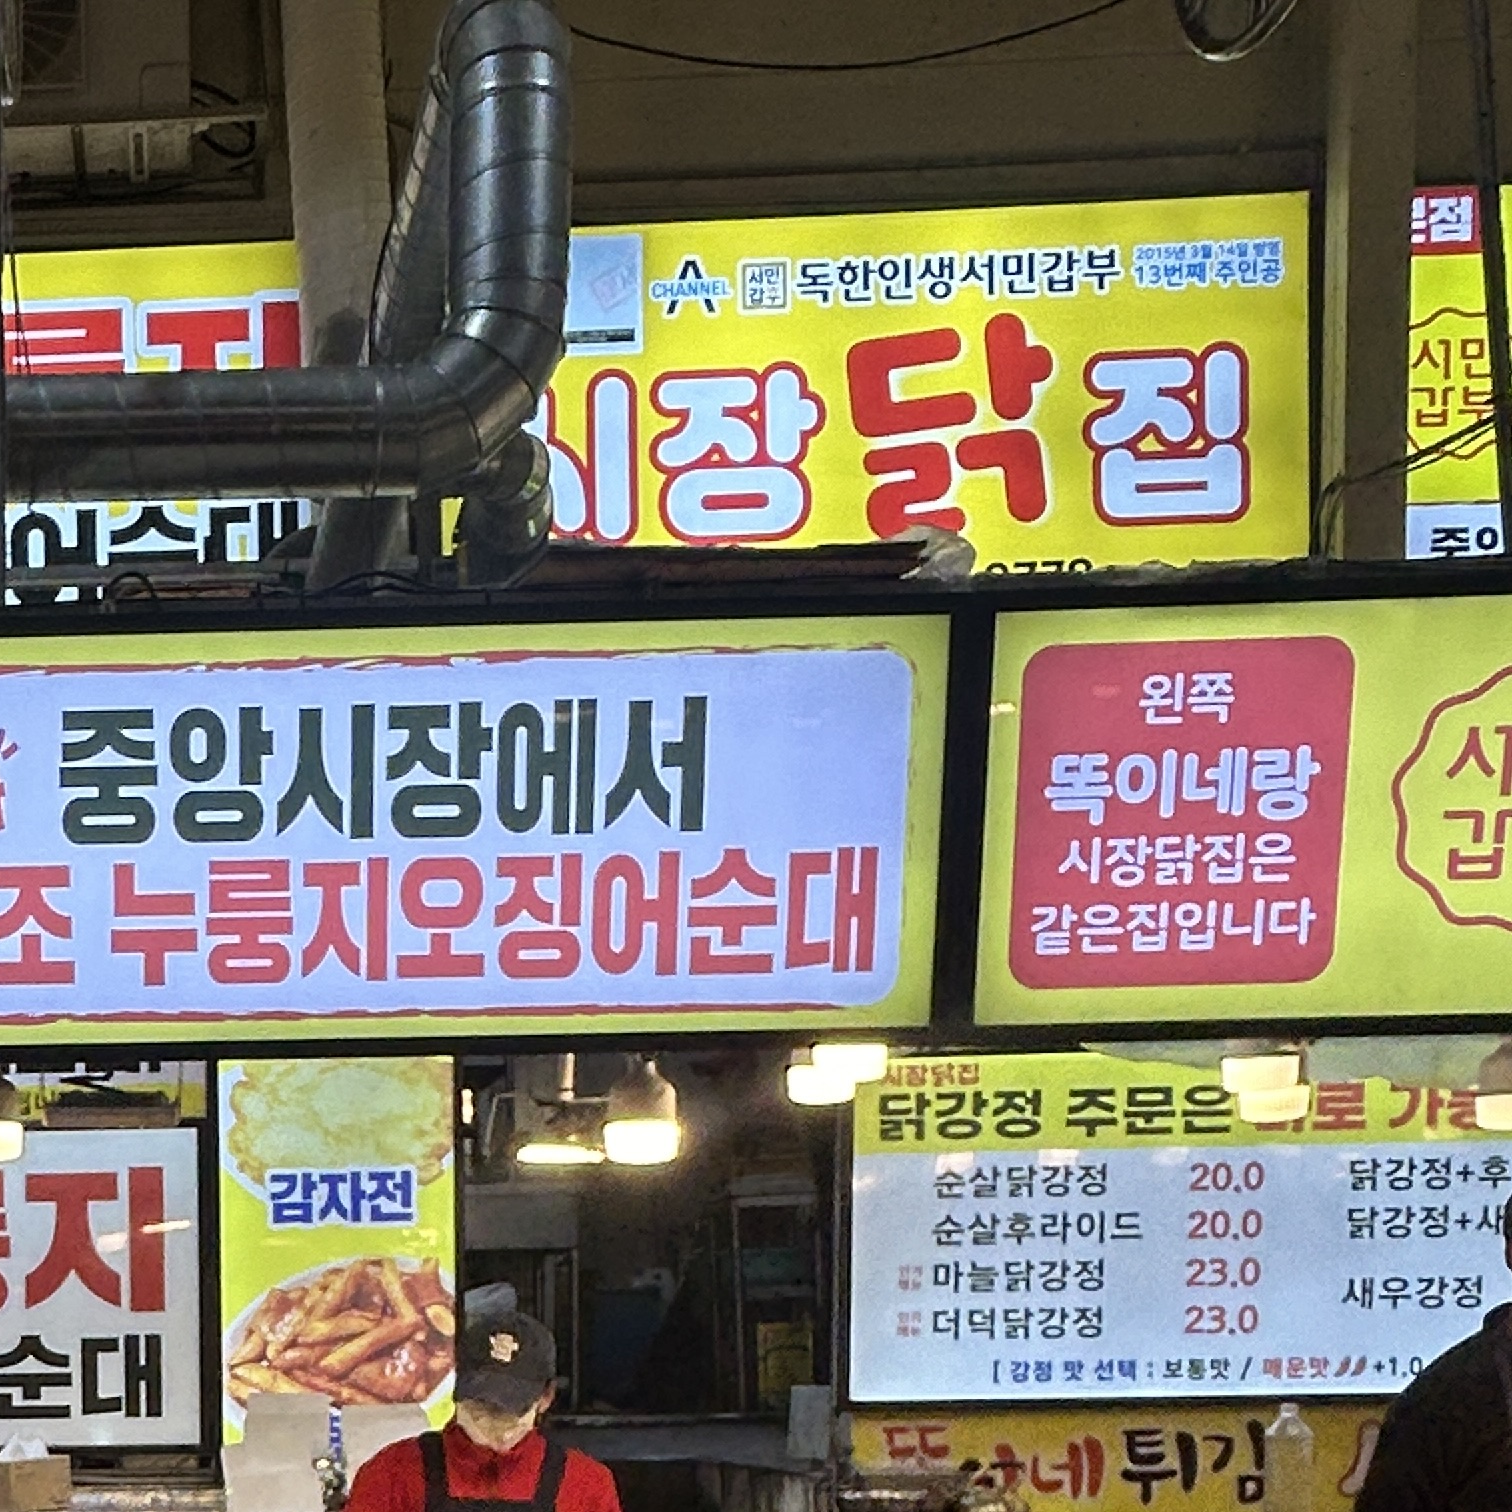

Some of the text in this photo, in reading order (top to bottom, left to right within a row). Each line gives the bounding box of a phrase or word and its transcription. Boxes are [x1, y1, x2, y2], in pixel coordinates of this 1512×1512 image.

[651, 280, 730, 299] CHANNEL
[796, 248, 1121, 304] 독한인생서민갑부
[1135, 257, 1281, 288] 13번째 주인공
[1139, 671, 1236, 725] 왼쪽
[57, 695, 710, 846] 중앙시장에서
[1044, 744, 1321, 826] 똑이네랑
[1058, 832, 1297, 888] 시장닭집은
[109, 846, 879, 987] 누룽지오징어순대
[1030, 897, 1317, 956] 같은집입니다
[878, 1088, 1042, 1141] 닭강정
[1065, 1084, 1234, 1138] 주문은
[1254, 1082, 1367, 1133] 로
[269, 1169, 414, 1225] 감자전
[933, 1163, 1109, 1200] 순살닭강정
[1189, 1161, 1266, 1193] 20.0
[931, 1210, 1144, 1247] 순살후라이드
[1187, 1210, 1264, 1241] 20.0
[932, 1256, 1484, 1311] 마늘닭강정 23.0 새우강정
[931, 1303, 1260, 1342] 더덕닭강정 23.0
[1094, 1358, 1137, 1382] 선택
[1162, 1357, 1231, 1382] 보통맛
[1262, 1356, 1330, 1381] 매운맛
[1120, 1419, 1266, 1505] 튀김
